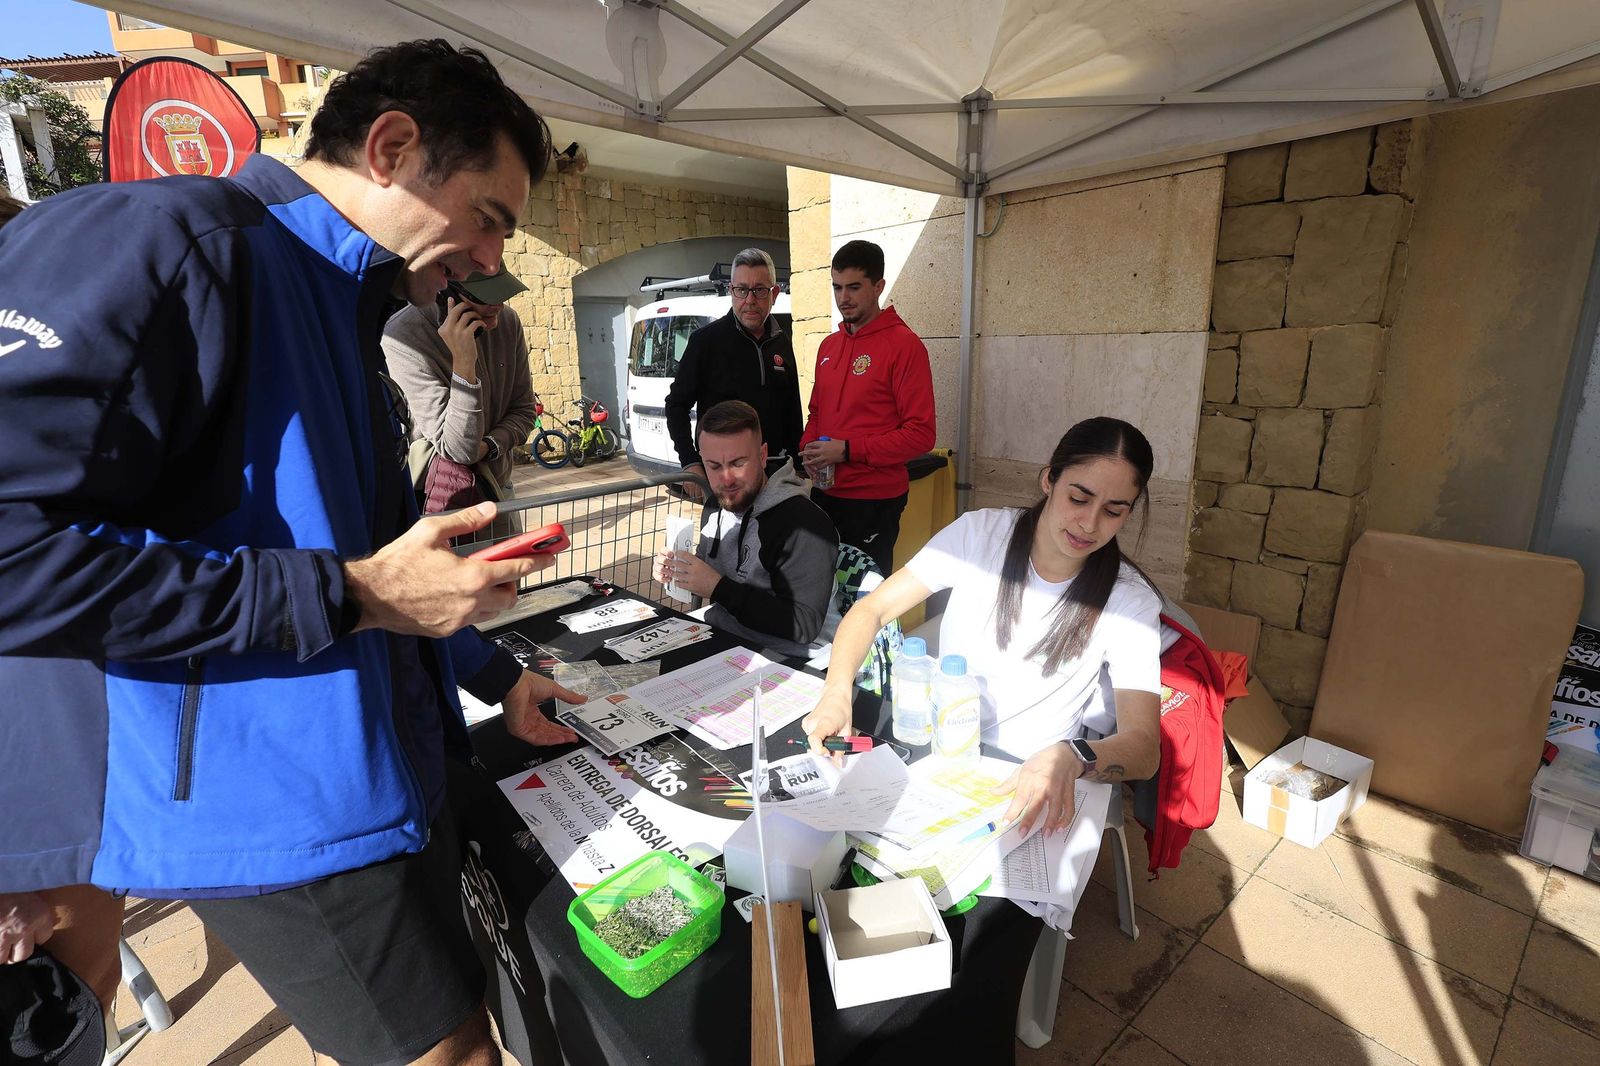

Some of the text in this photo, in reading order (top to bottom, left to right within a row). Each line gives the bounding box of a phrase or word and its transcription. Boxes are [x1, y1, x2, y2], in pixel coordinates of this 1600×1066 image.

[594, 607, 619, 617] 88
[634, 627, 670, 643] 142
[641, 641, 668, 654] RUN
[591, 713, 624, 731] 73
[641, 711, 670, 728] RUN
[566, 754, 615, 798] ENTREGA
[606, 793, 632, 811] DE
[787, 770, 820, 787] RUN
[545, 764, 613, 832] Carrera de Adultos
[536, 791, 568, 822] Apellidos
[561, 817, 575, 832] de
[574, 833, 590, 845] N
[582, 842, 605, 867] hasta
[598, 863, 615, 873] Z
